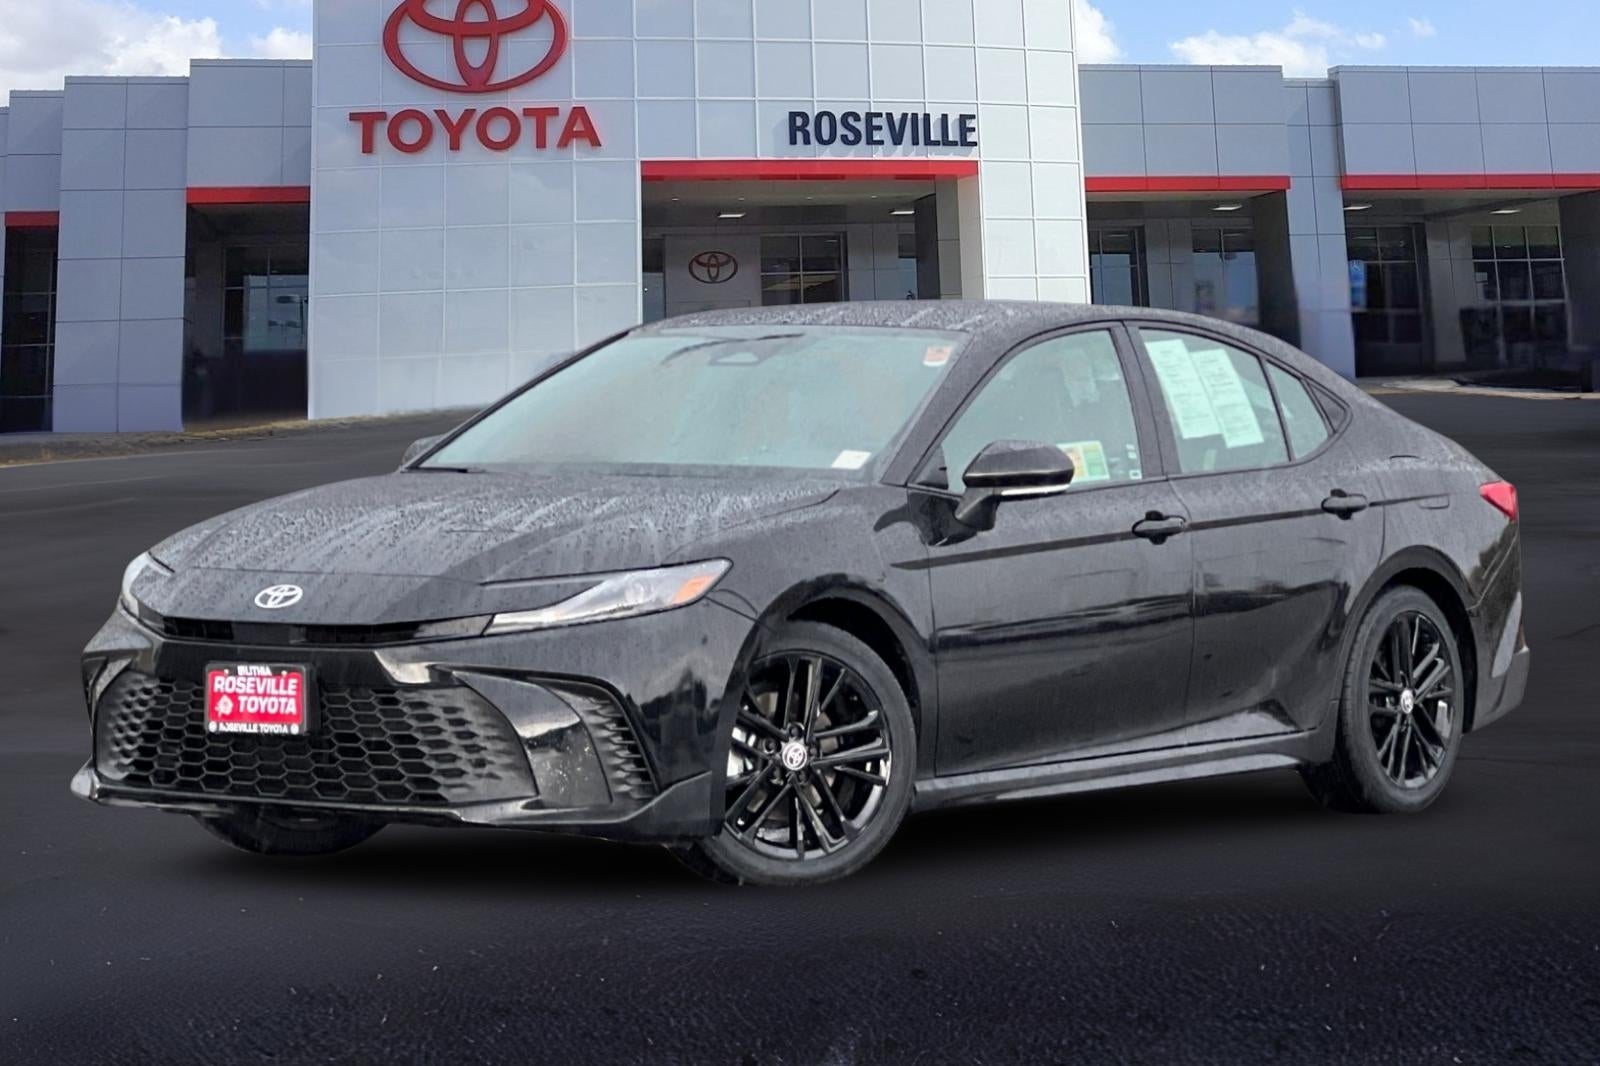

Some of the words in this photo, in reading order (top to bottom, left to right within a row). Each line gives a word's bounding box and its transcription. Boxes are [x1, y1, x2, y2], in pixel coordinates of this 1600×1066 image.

[349, 106, 602, 154] TOYOTA
[788, 110, 977, 147] ROSEVILLE
[214, 676, 298, 695] ROSEVILLE
[238, 695, 297, 714] TOYOTA
[259, 723, 288, 733] TOYOTA
